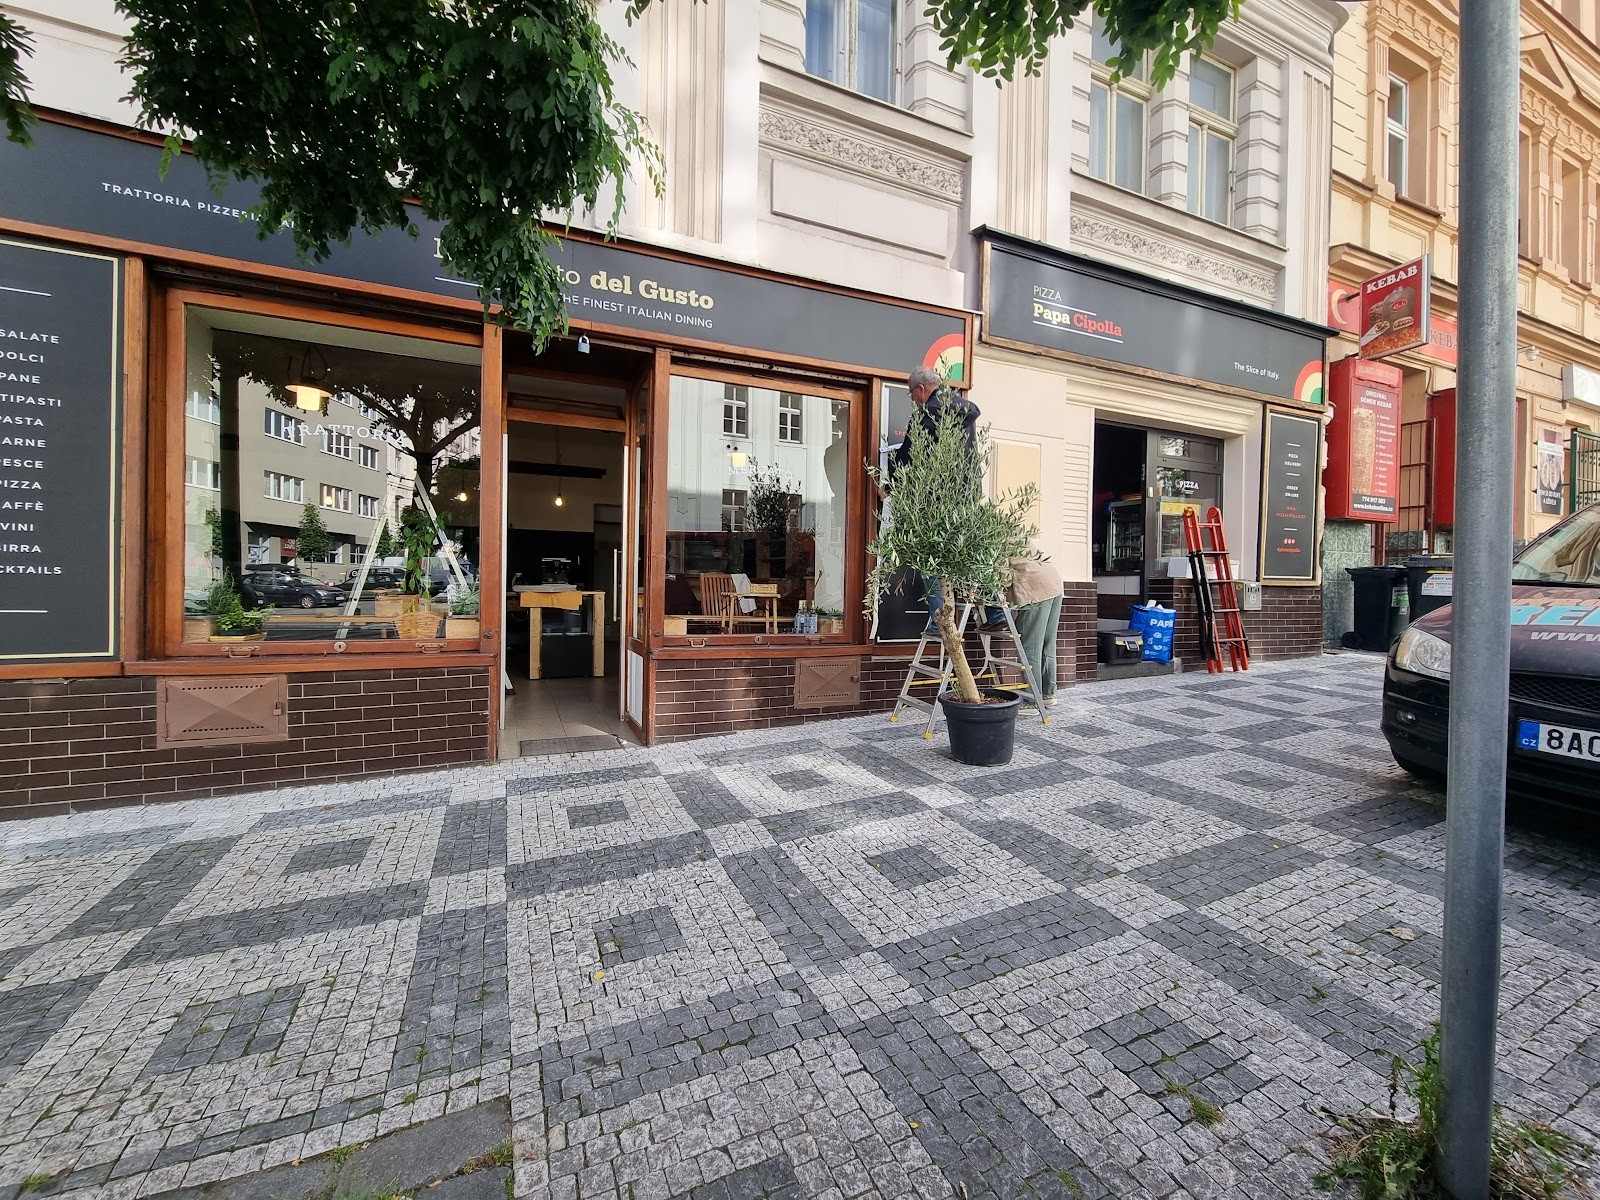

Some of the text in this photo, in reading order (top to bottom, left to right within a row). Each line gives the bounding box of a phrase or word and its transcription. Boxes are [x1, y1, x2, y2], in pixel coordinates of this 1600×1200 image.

[102, 182, 191, 208] TRATTORIA
[1366, 265, 1418, 293] KEBAB
[590, 271, 714, 309] del Gusto
[1033, 285, 1062, 301] PIZZA
[583, 297, 624, 313] FINEST
[627, 305, 672, 322] ITALIAN
[675, 314, 713, 329] DINING
[1033, 303, 1122, 336] Papa Cipolla
[1430, 329, 1457, 350] KEB
[1234, 361, 1245, 372] The
[1246, 364, 1259, 375] Slice
[1260, 368, 1266, 377] of
[1365, 390, 1388, 400] ORIGINAL
[0, 415, 44, 427] ASTA
[2, 437, 46, 448] ARNE
[0, 458, 44, 469] ESCE
[727, 464, 793, 480] MERCATO
[1180, 480, 1199, 490] PIZZA
[2, 501, 44, 511] AFFÈ
[0, 523, 34, 532] VINI
[0, 544, 42, 553] IRRA
[1522, 738, 1537, 746] CZ
